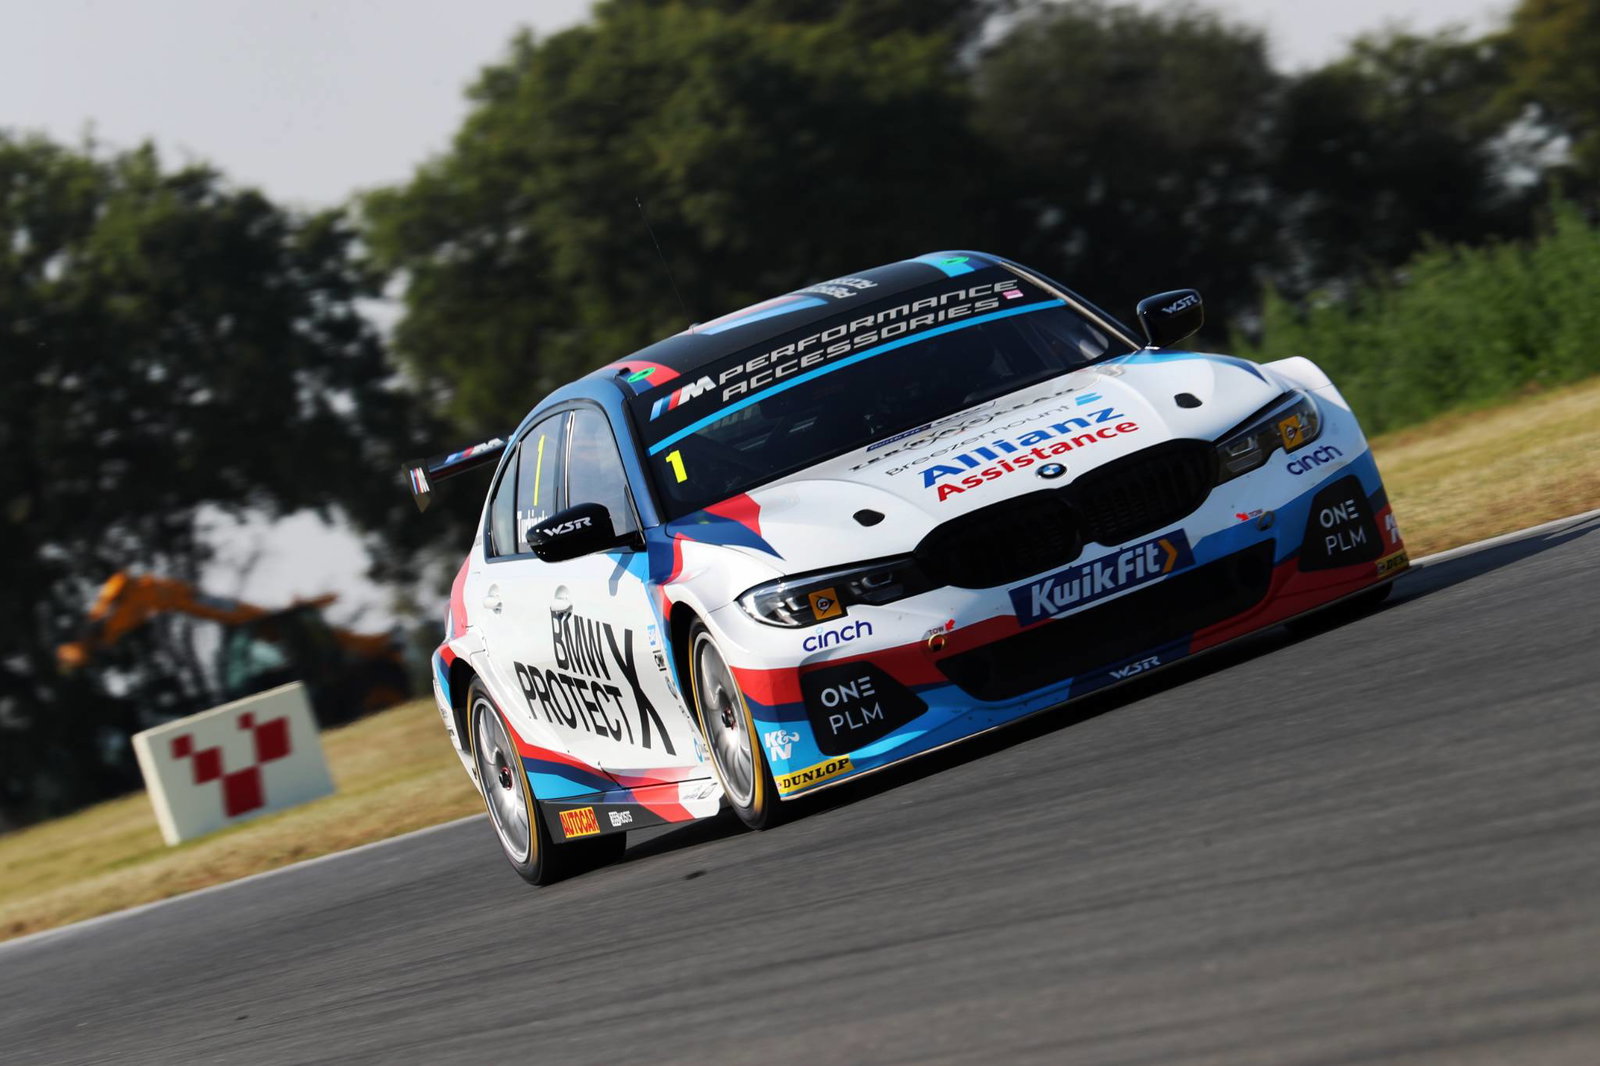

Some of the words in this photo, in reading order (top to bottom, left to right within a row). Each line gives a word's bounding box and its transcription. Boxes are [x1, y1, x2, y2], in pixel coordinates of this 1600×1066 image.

[1161, 294, 1198, 314] WSR
[719, 279, 1018, 386] PERFORMANCE
[722, 297, 999, 402] ACCESSORIES
[918, 407, 1125, 488] Allianz
[937, 421, 1139, 502] Assistance
[1287, 445, 1343, 475] cinch
[665, 450, 688, 483] 1
[543, 517, 592, 536] WSR
[1320, 499, 1359, 528] ONE
[1325, 526, 1367, 556] PLM
[551, 611, 611, 681] BMW
[803, 620, 873, 652] cinch
[1109, 656, 1160, 679] WSR
[514, 661, 634, 744] PROTECT
[821, 676, 876, 708] ONE
[829, 702, 884, 735] PLM
[783, 757, 849, 789] DUNLOP
[560, 807, 600, 837] AUTOCAR
